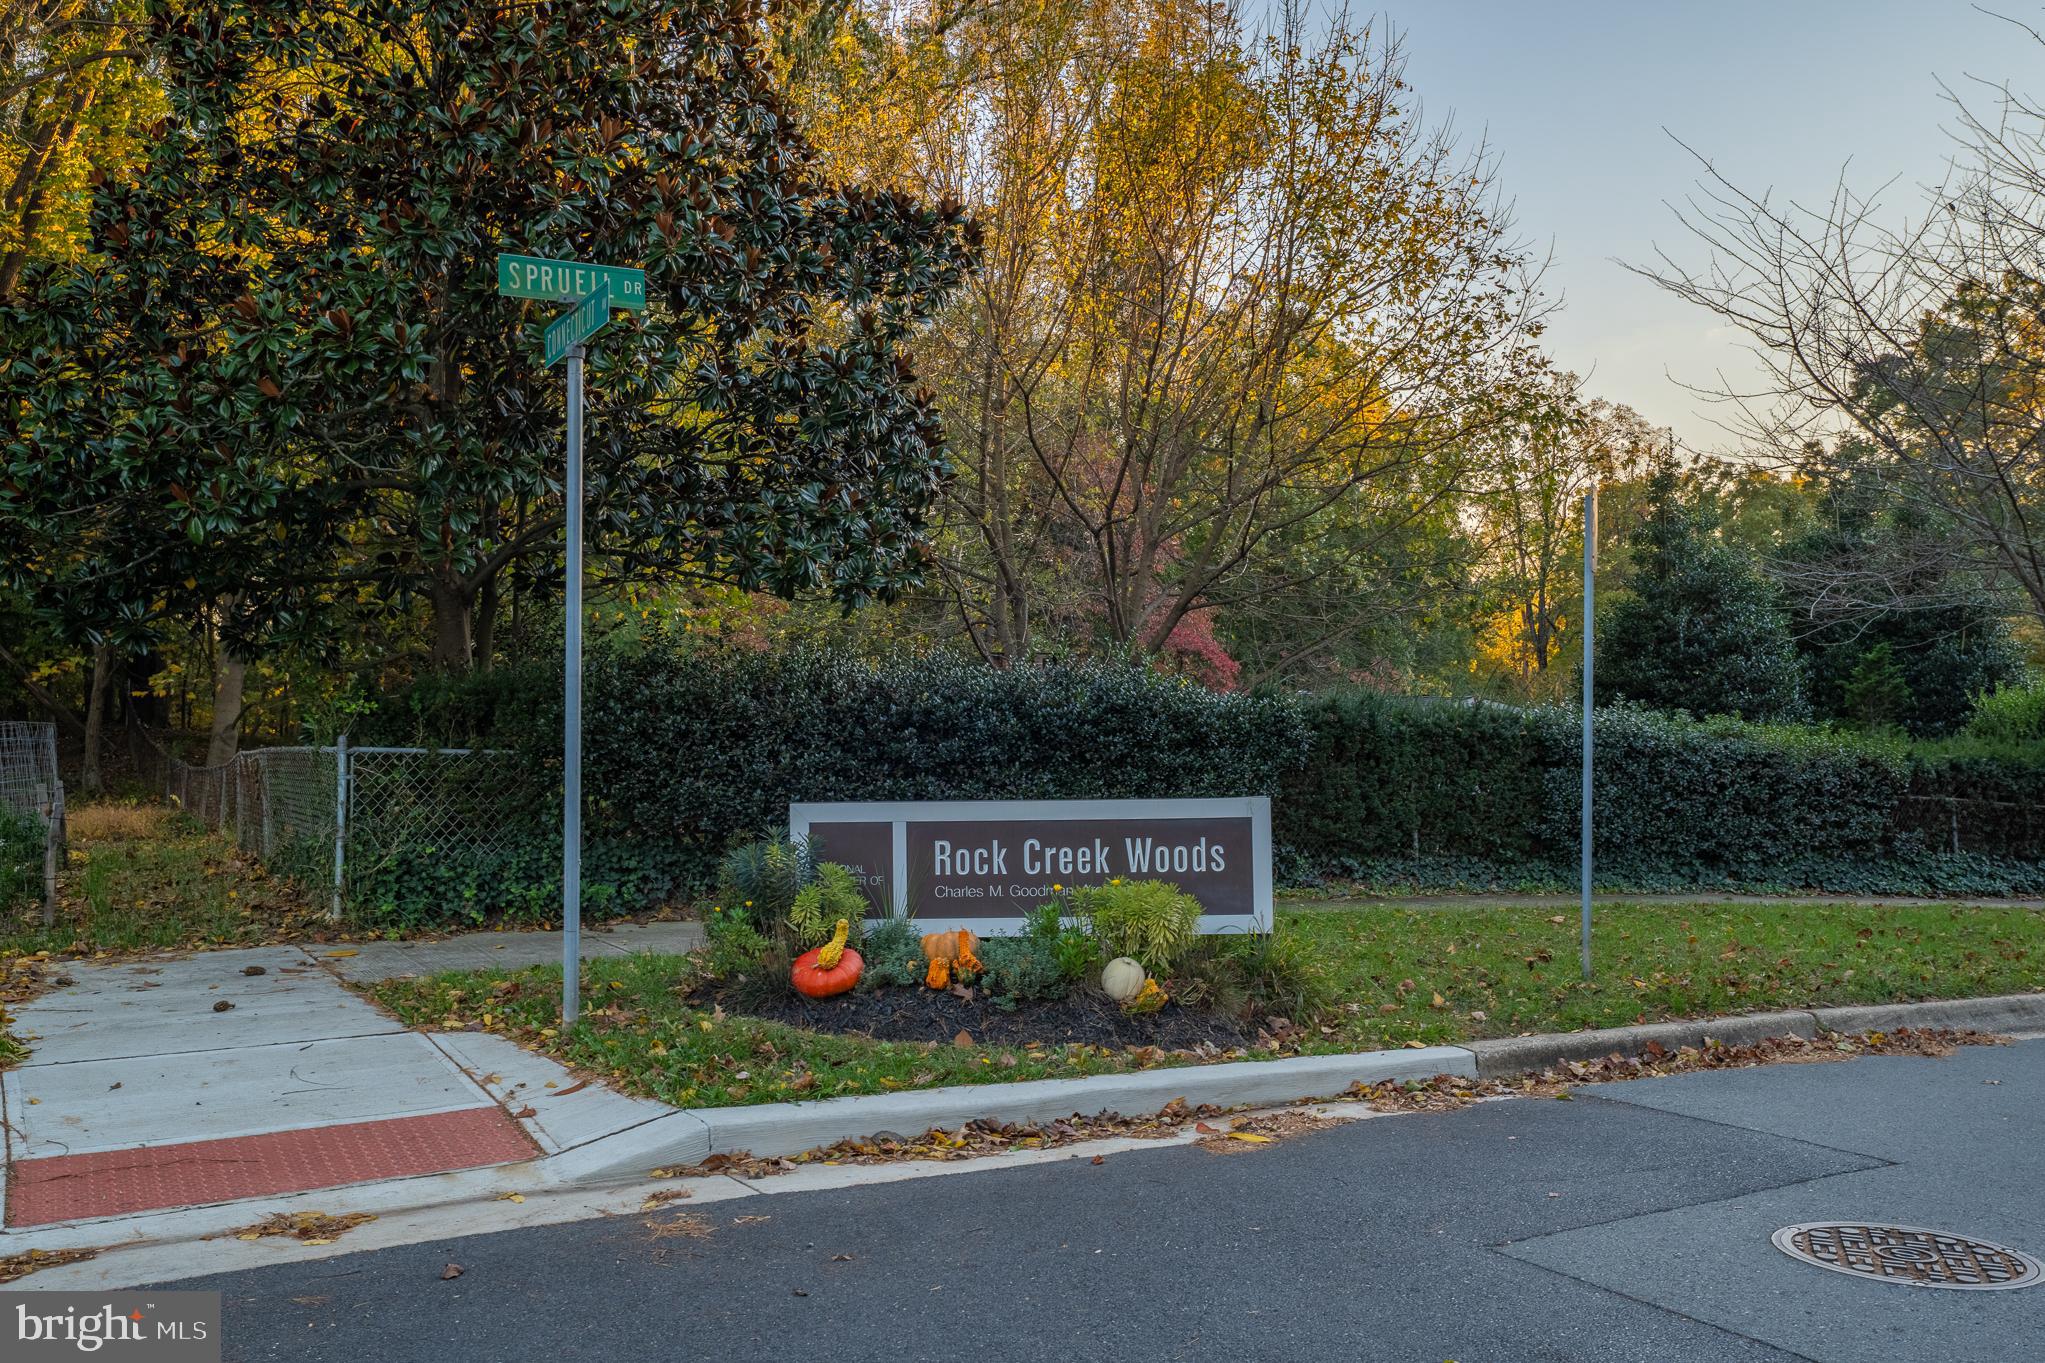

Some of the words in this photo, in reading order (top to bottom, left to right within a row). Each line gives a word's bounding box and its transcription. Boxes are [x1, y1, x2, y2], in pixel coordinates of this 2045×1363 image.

[624, 281, 642, 295] DR
[547, 300, 596, 359] CONNECTICUT
[935, 839, 1007, 875] Rock
[1023, 838, 1110, 874] Creek
[1125, 837, 1225, 873] Woods
[934, 885, 984, 898] Charles
[989, 885, 1004, 897] M.
